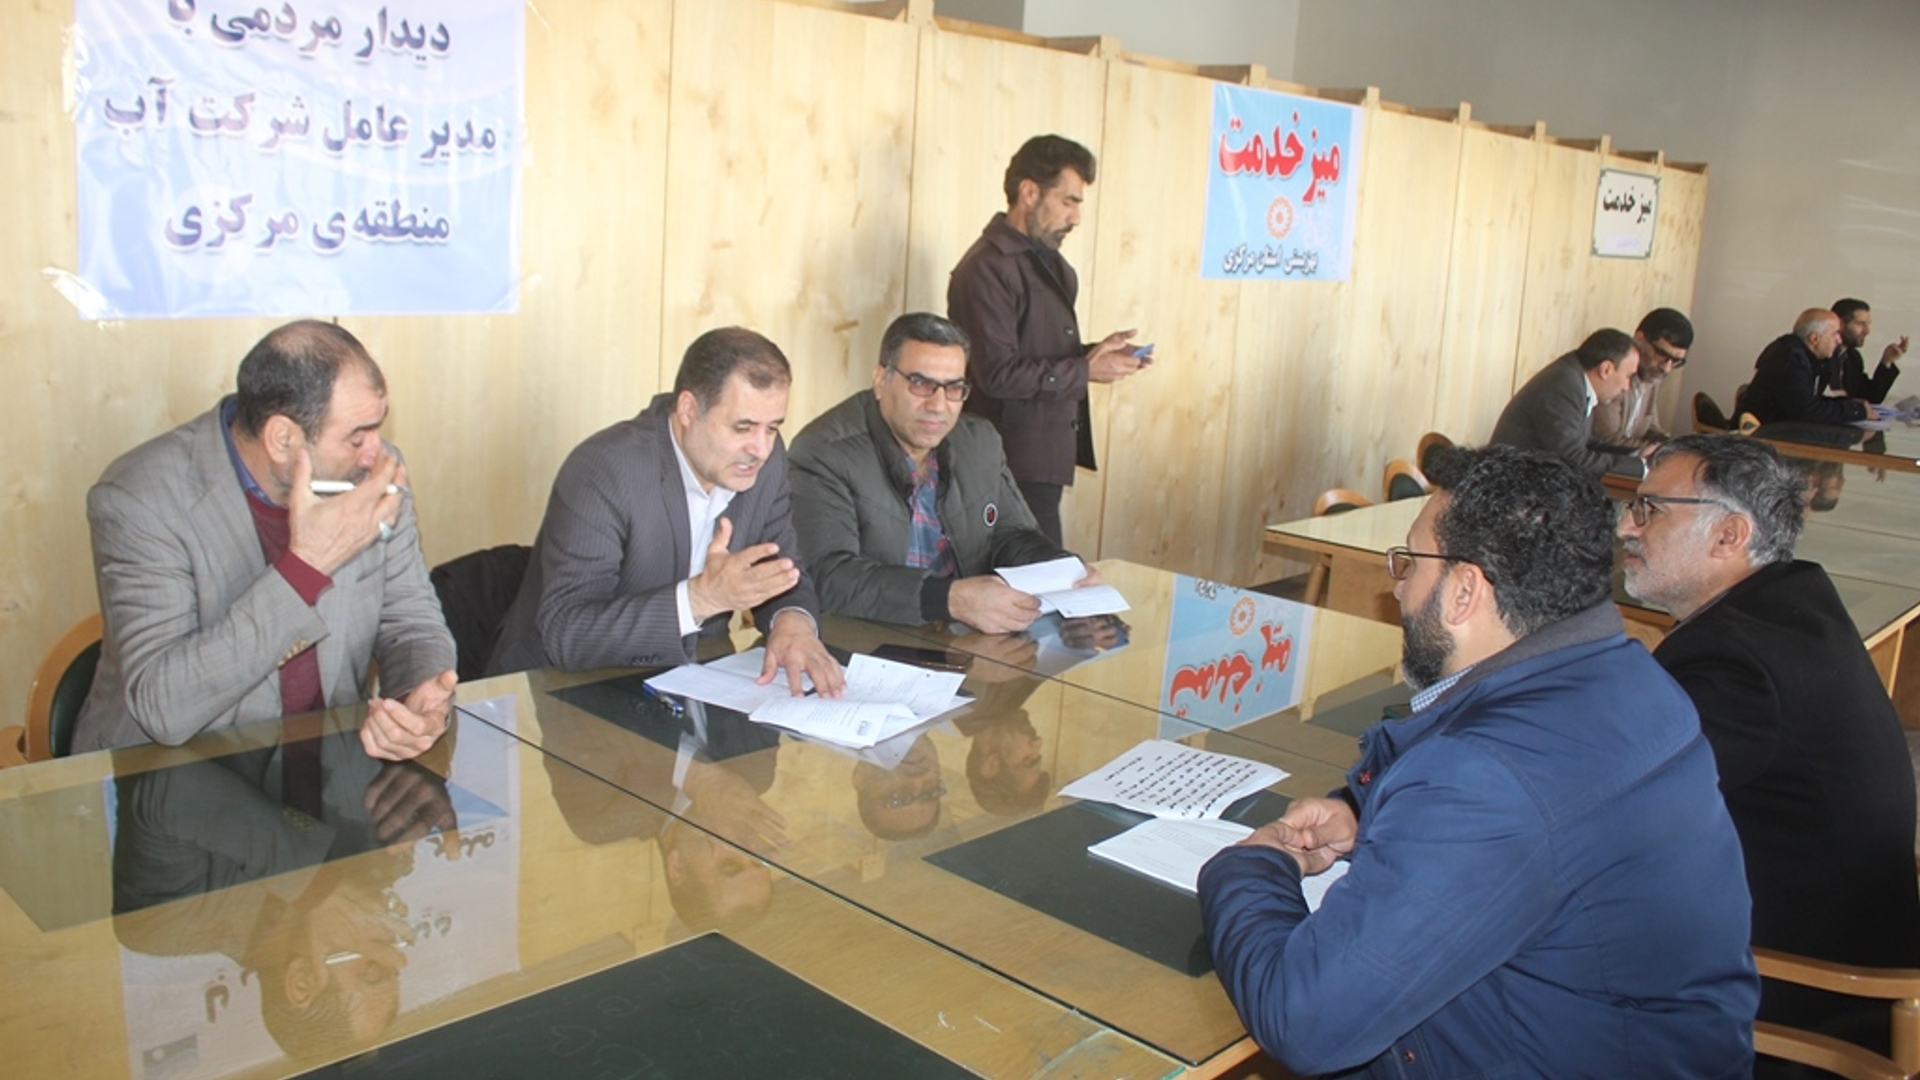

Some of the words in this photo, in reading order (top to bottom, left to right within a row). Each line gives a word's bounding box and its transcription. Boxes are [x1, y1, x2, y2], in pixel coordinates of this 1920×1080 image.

[211, 1, 342, 56] مردمی
[355, 6, 450, 60] دیدار
[104, 76, 172, 134] آب
[189, 93, 310, 147] شرکت
[323, 100, 408, 151] عامل
[420, 119, 496, 158] مدیر
[1219, 111, 1304, 176] خدمت
[1302, 128, 1340, 203] میز
[166, 194, 297, 247] مرکزی
[1603, 186, 1636, 212] خدمت
[1637, 193, 1652, 224] میز
